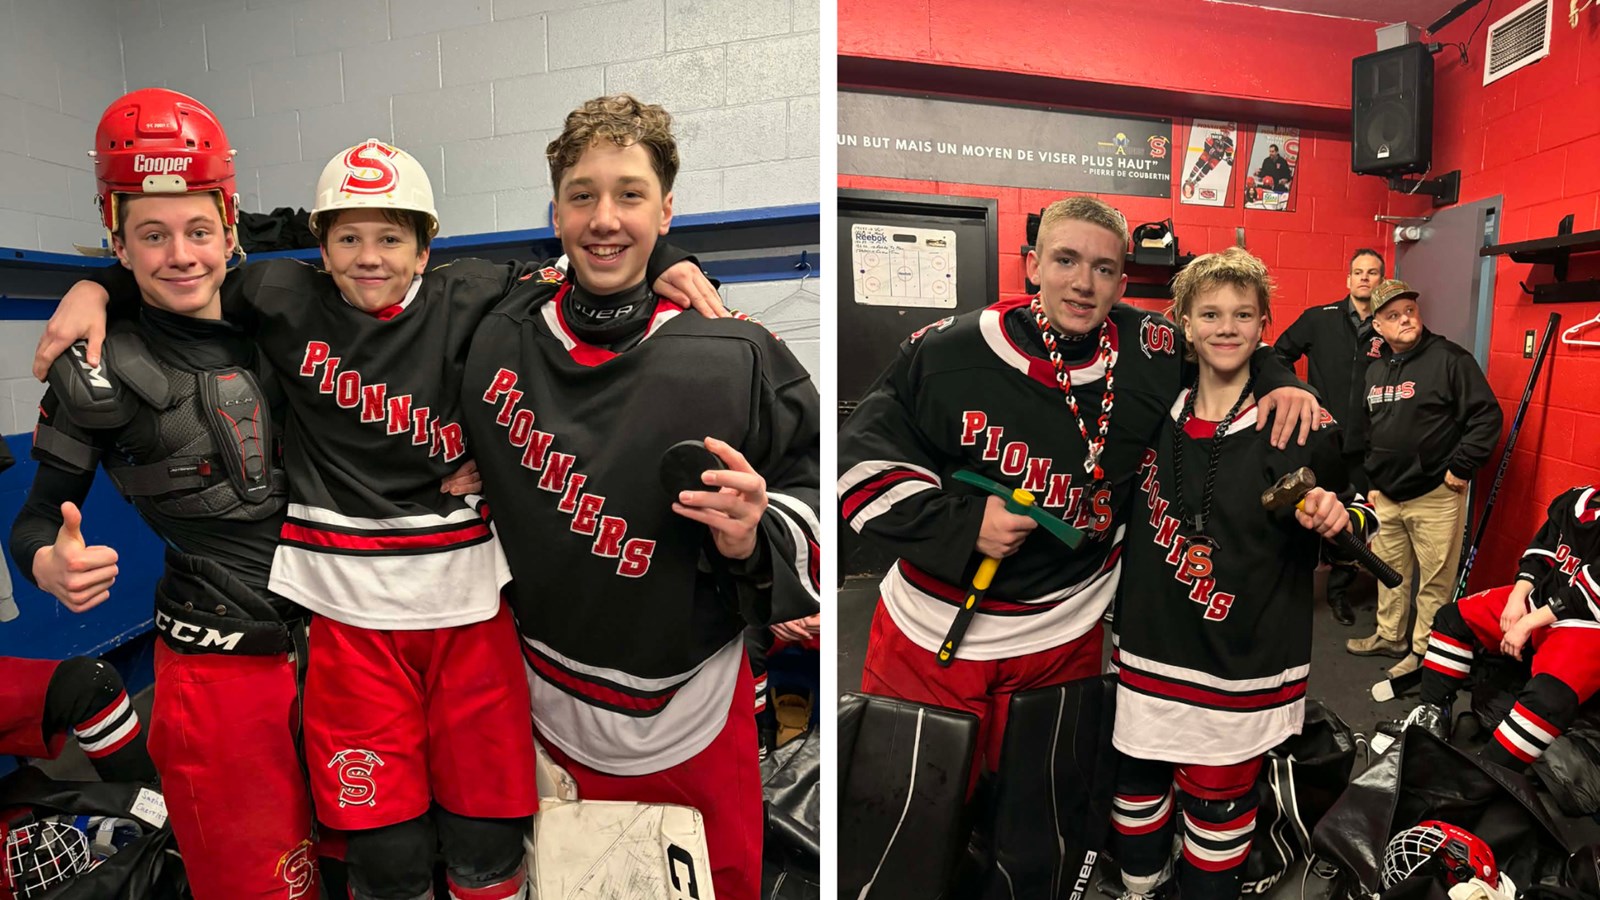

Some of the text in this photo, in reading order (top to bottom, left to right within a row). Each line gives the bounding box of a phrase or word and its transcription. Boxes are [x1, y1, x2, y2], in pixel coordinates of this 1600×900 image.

[134, 154, 193, 175] Cooper
[340, 142, 399, 195] S
[837, 134, 857, 146] UN
[863, 136, 890, 149] BUT
[895, 139, 932, 152] MAIS
[937, 142, 957, 155] UN
[962, 145, 1013, 160] MOYEN
[1017, 149, 1034, 161] DE
[1038, 151, 1077, 165] VISER
[1081, 155, 1113, 167] PLUS
[1089, 168, 1115, 177] PIERRE
[1128, 171, 1170, 181] COUBERTIN
[855, 232, 888, 243] Reebok
[300, 341, 459, 463] PIONNIER
[483, 367, 656, 578] PIONNIERS
[156, 609, 245, 650] CCM
